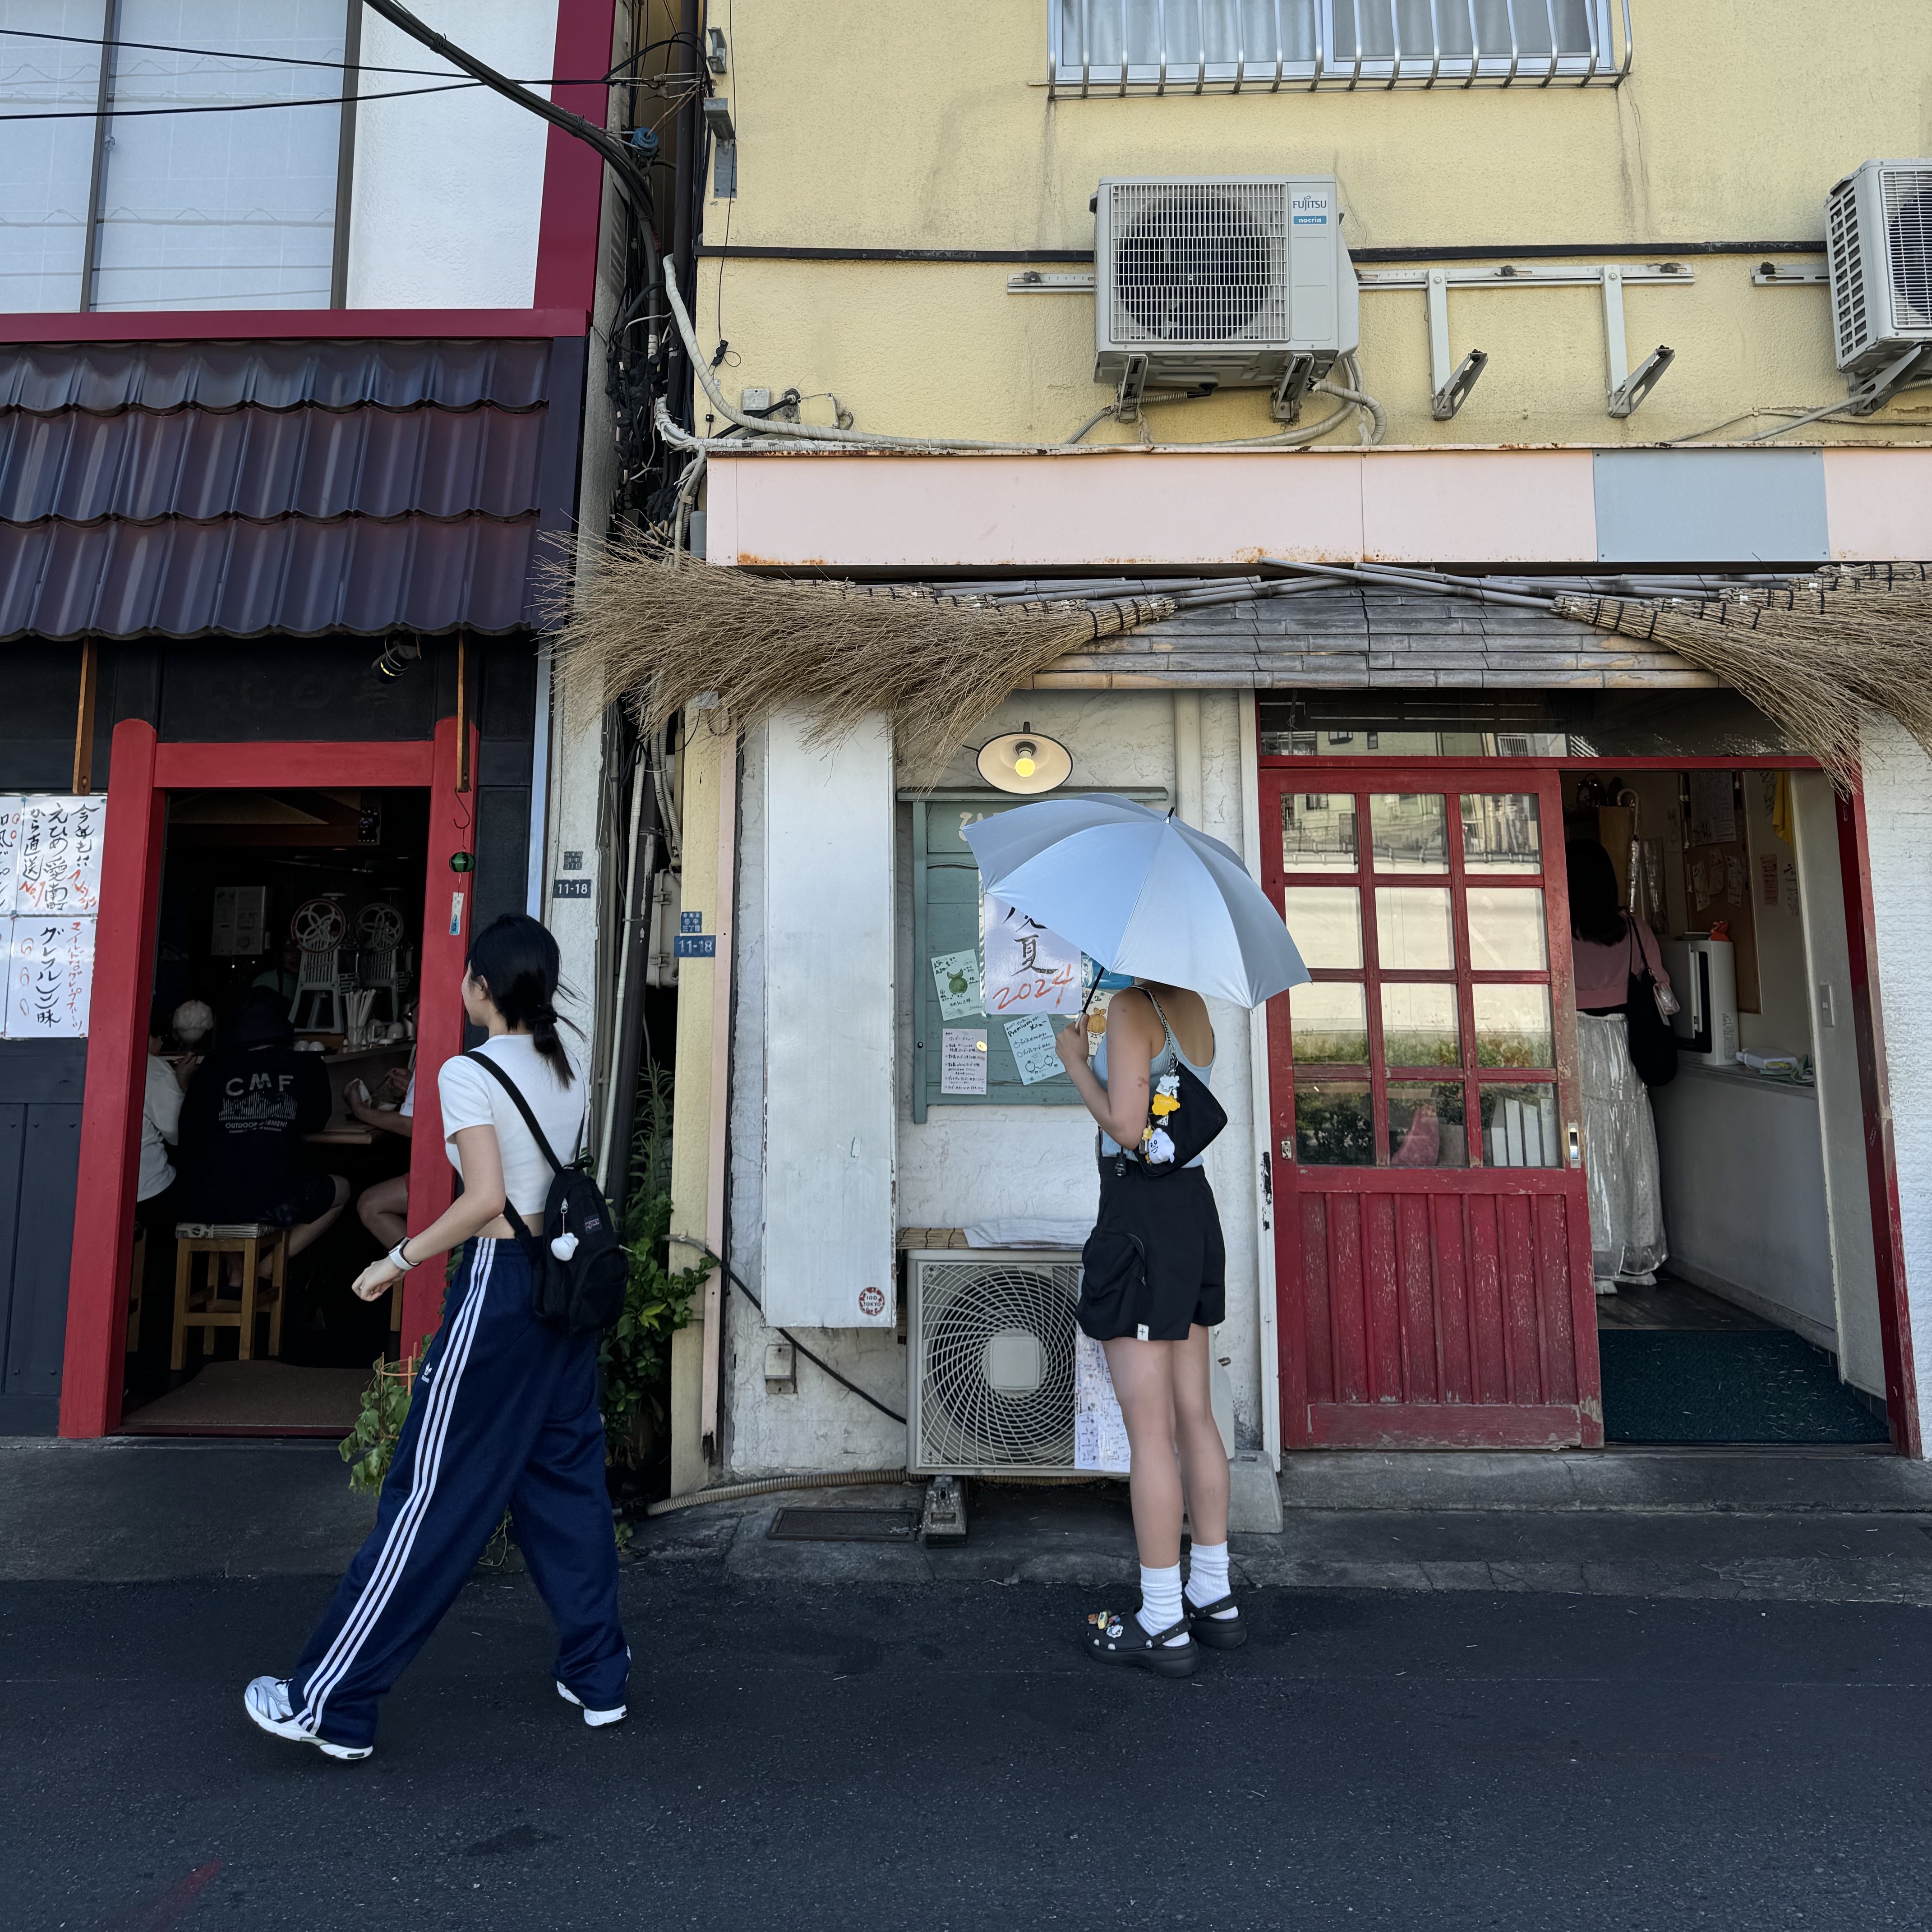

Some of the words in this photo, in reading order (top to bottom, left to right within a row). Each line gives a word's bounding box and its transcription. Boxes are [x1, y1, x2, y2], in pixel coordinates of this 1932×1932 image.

[1293, 196, 1327, 211] FUJITSU
[23, 808, 46, 882] から直送
[558, 883, 588, 894] 11-18
[679, 940, 712, 953] 11-18
[1011, 934, 1059, 977] 夏
[992, 963, 1074, 1010] 2024
